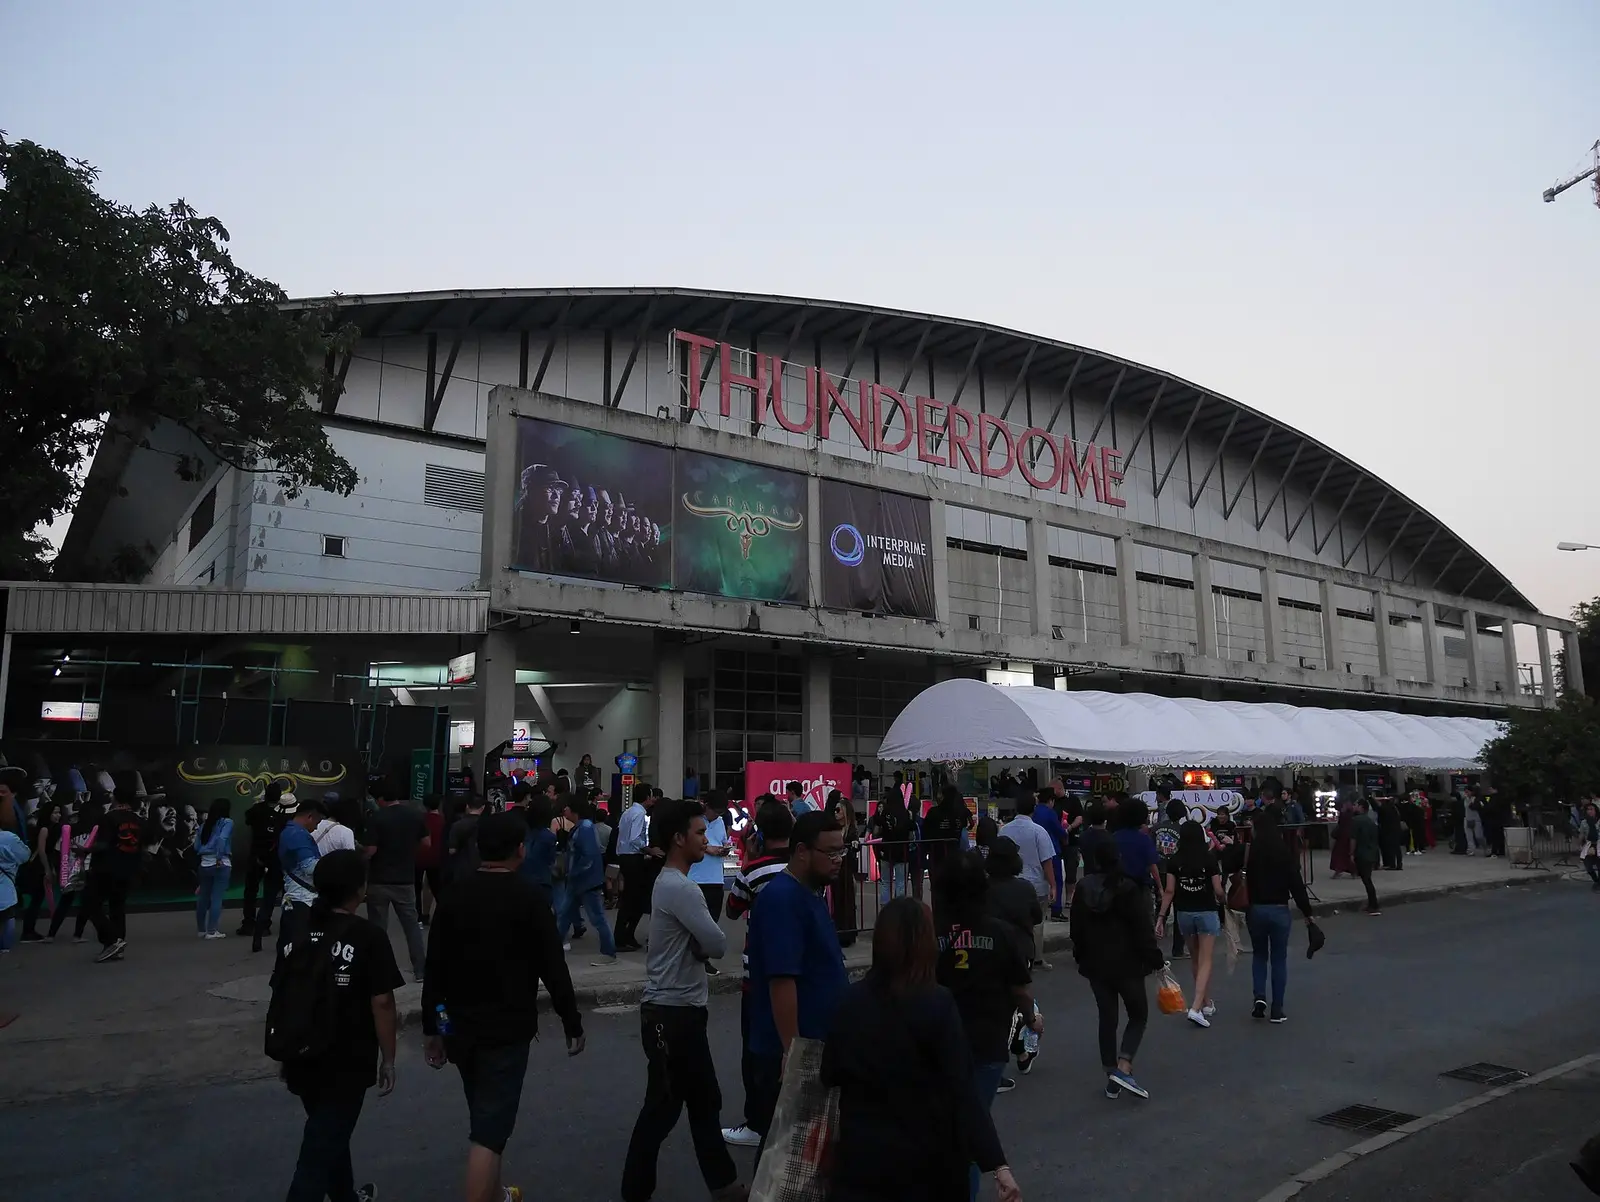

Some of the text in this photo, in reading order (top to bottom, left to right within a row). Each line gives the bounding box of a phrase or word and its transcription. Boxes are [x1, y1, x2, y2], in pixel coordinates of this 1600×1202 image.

[675, 329, 1126, 508] THUNDERDOME
[693, 490, 796, 518] CARABAO
[866, 534, 926, 556] INTERPRIME
[882, 552, 915, 570] MEDIA
[193, 757, 334, 773] CARABAO
[1140, 792, 1231, 804] CABAO
[954, 950, 969, 969] 2
